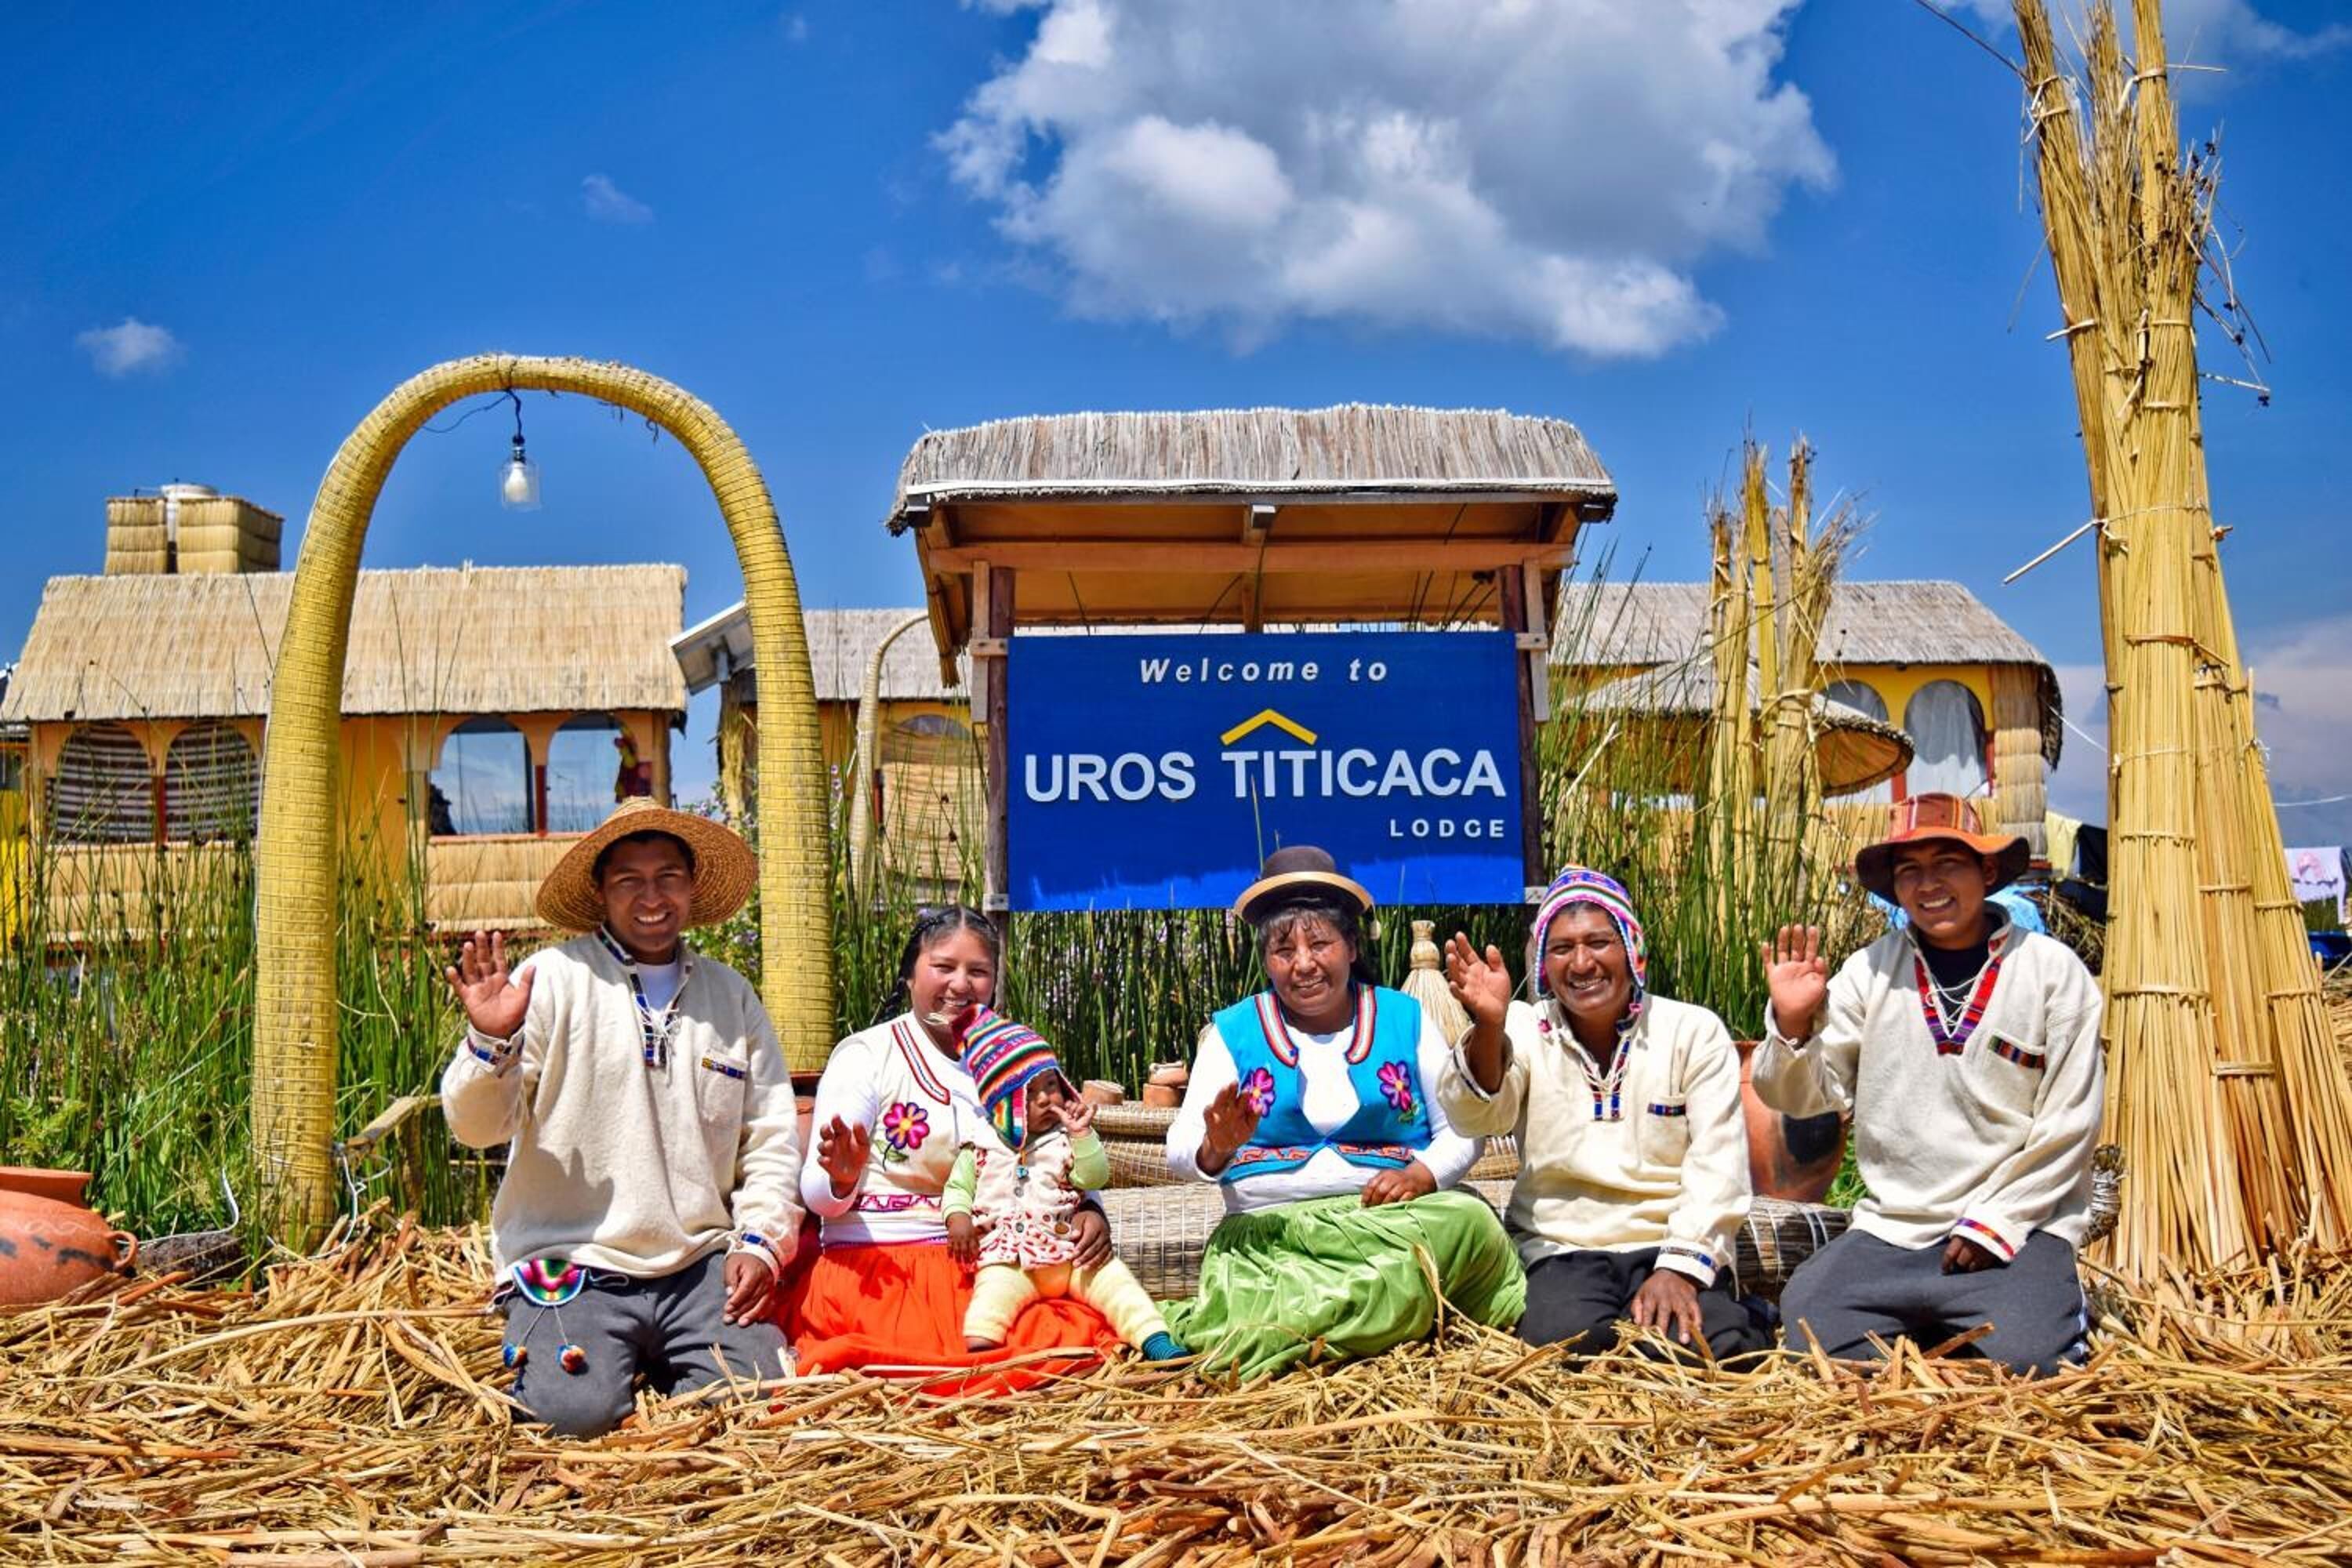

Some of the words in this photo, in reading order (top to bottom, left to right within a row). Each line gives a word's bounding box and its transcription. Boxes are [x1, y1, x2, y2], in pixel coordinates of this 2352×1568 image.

[1140, 658, 1319, 683] Welcome
[1348, 658, 1388, 681] to
[1024, 750, 1196, 802] UROS
[1220, 747, 1507, 798] TITICACA
[1389, 818, 1504, 837] LODGE
